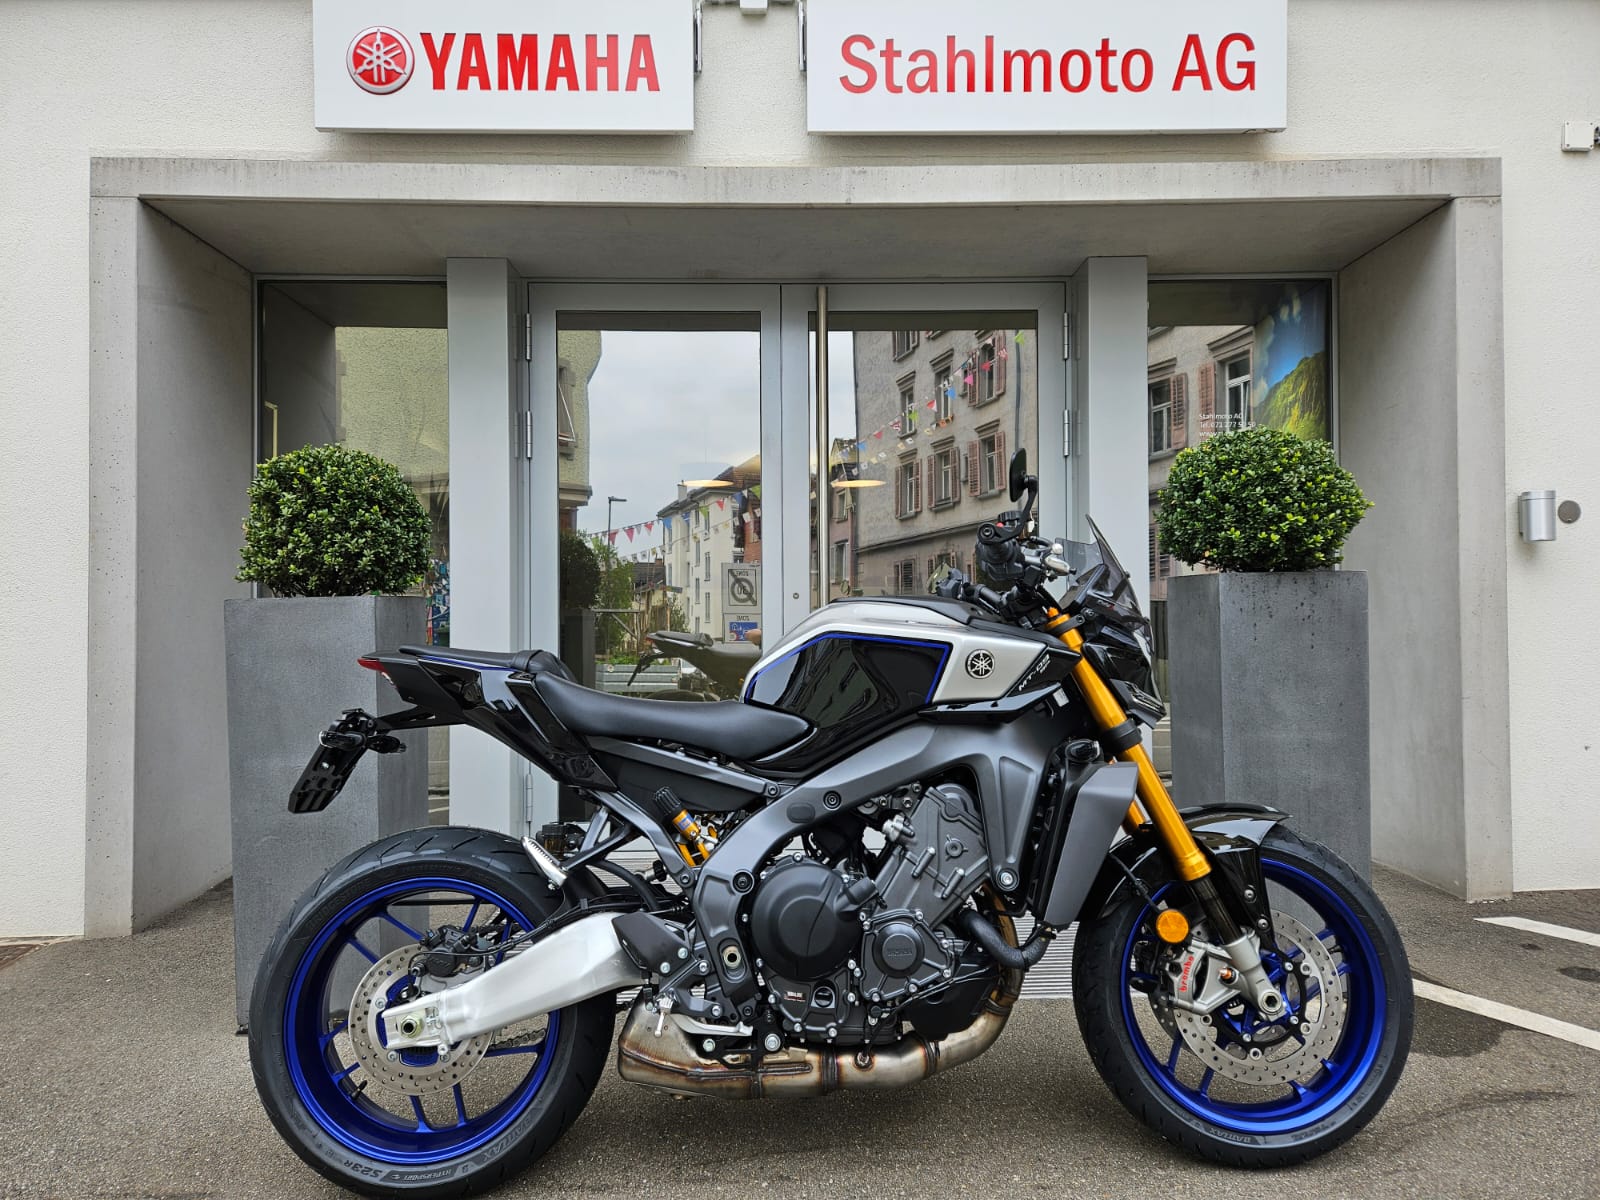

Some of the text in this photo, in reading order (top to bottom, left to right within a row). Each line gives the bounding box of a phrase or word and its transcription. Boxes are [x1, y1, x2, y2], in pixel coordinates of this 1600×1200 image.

[420, 33, 660, 92] YAMAHA
[839, 33, 1256, 94] Stahlmoto AG
[1179, 956, 1194, 992] brembo
